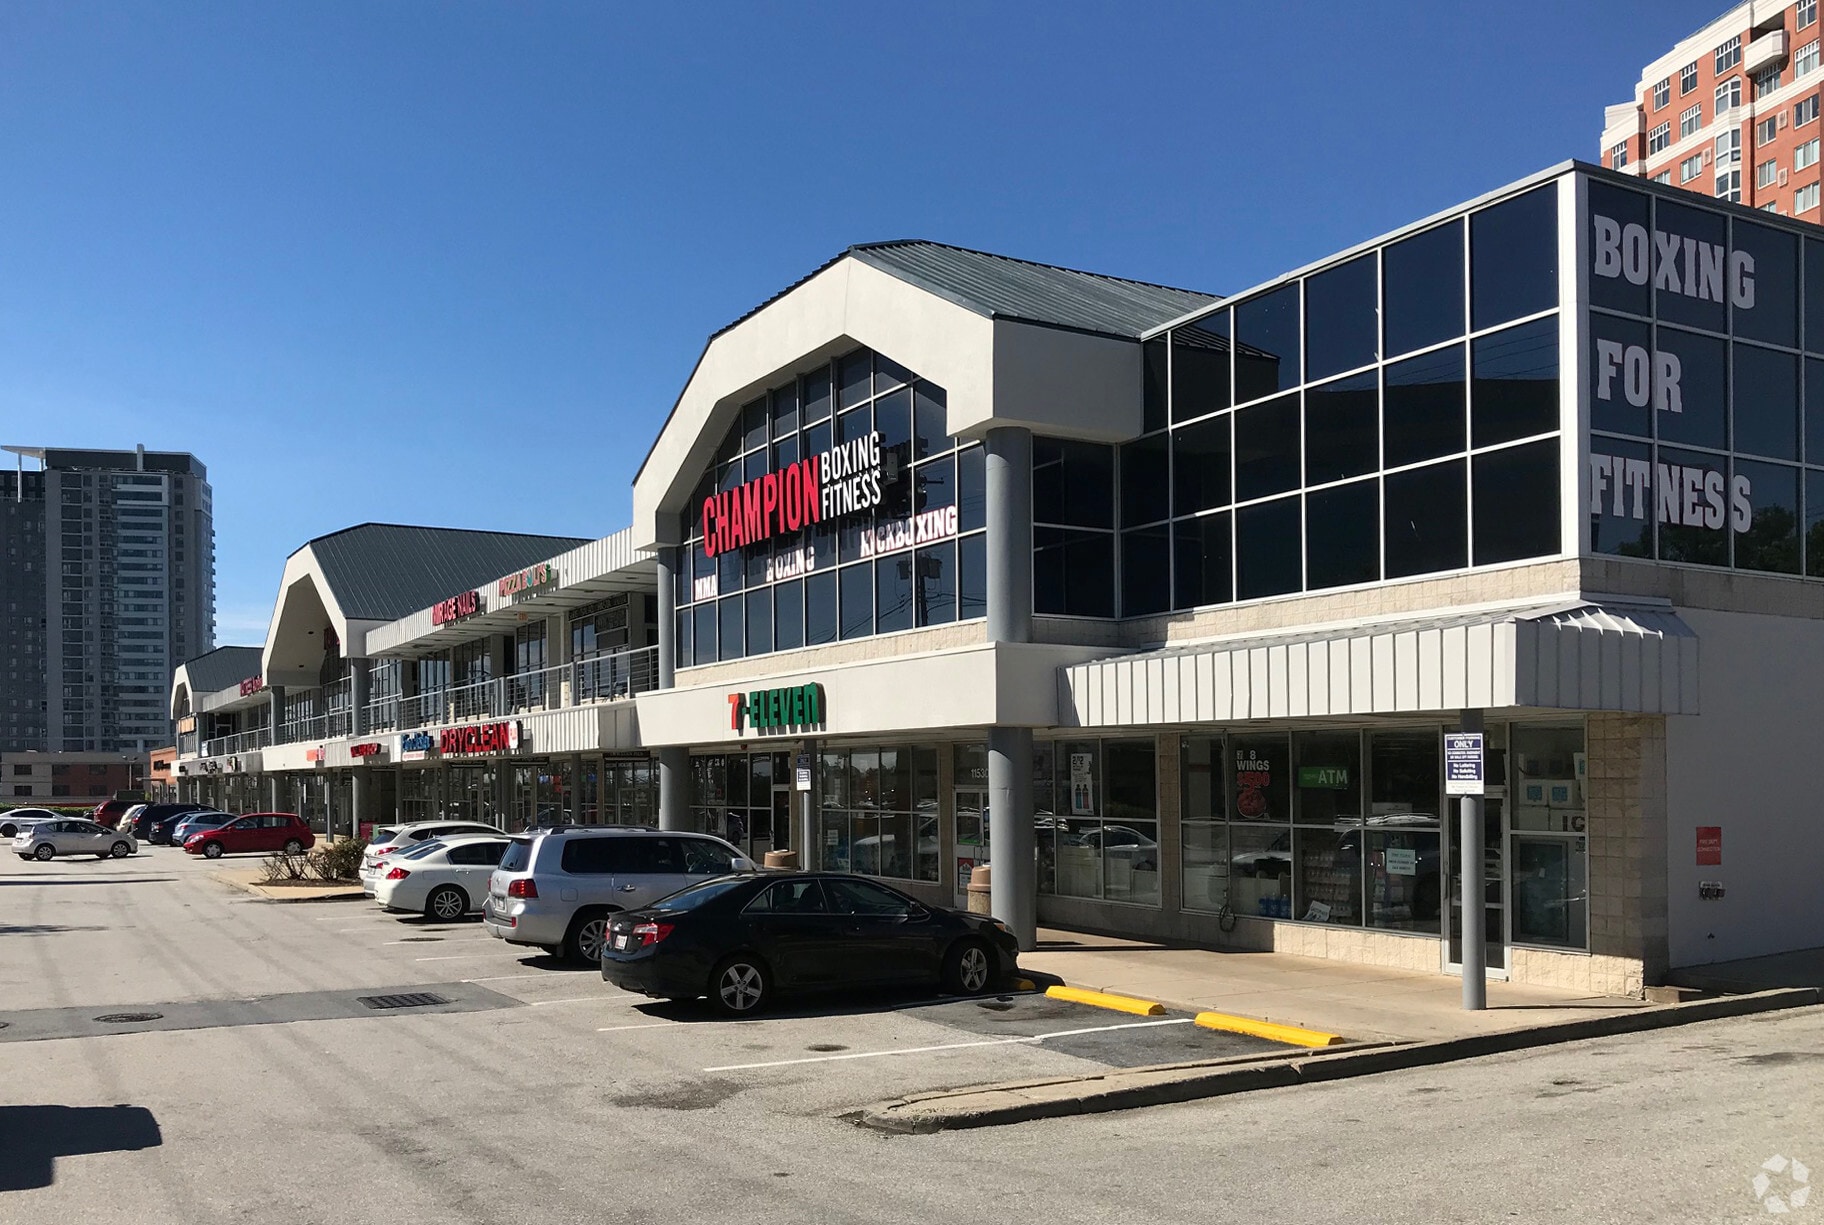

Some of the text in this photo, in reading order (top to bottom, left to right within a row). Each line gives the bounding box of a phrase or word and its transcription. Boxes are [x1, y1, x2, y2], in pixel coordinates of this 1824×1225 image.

[1593, 214, 1755, 309] BOXING
[1596, 338, 1683, 413] FOR
[821, 431, 881, 483] BOXING
[702, 455, 820, 558] CHAMPION
[822, 469, 882, 521] FITNESS
[1590, 453, 1752, 533] FITNESS
[860, 505, 957, 557] KICKBOXING
[766, 545, 815, 582] BOXING
[499, 573, 522, 597] PIZZA
[694, 574, 717, 601] MMA
[432, 590, 477, 626] MIRAGE NAILS
[440, 721, 510, 754] DRYCLEAN
[1249, 750, 1257, 760] 8
[1453, 740, 1474, 748] ONLY
[1236, 760, 1270, 771] WINGS
[1317, 769, 1348, 784] ATM
